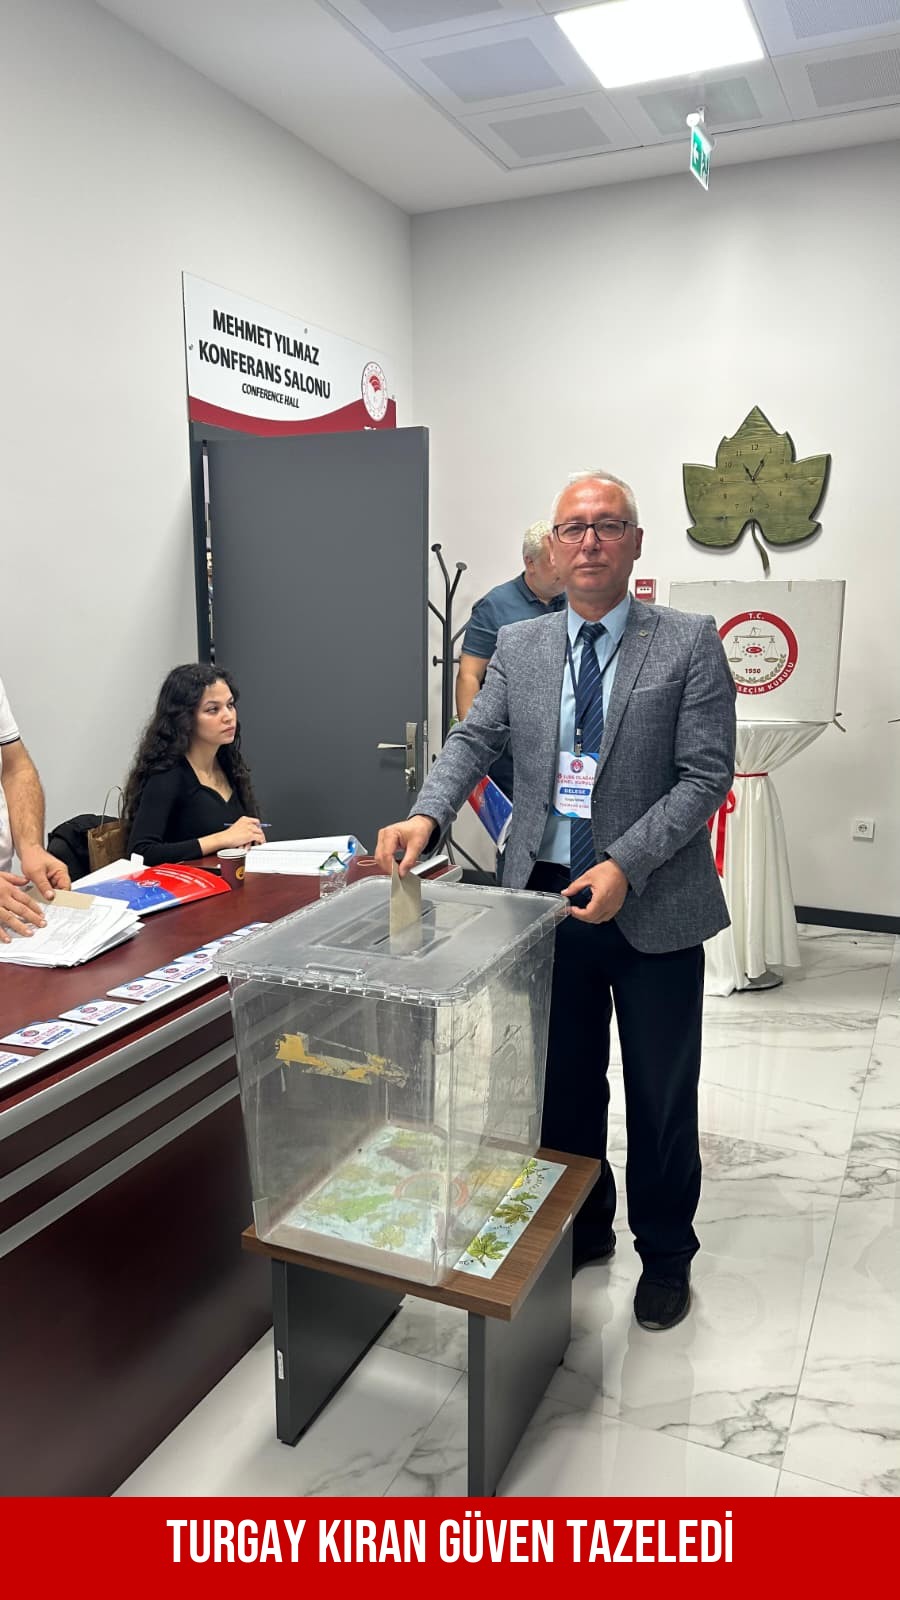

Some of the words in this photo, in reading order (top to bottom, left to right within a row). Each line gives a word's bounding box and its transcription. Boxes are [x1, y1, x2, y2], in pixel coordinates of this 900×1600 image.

[212, 309, 273, 349] MEHMET
[274, 331, 320, 366] YILMAZ
[198, 339, 282, 384] KONFERANS
[284, 368, 331, 399] SALONU
[241, 382, 284, 404] CONFERENCE
[284, 394, 300, 409] HALL
[748, 612, 765, 620] T.C.
[767, 661, 794, 690] KURULU
